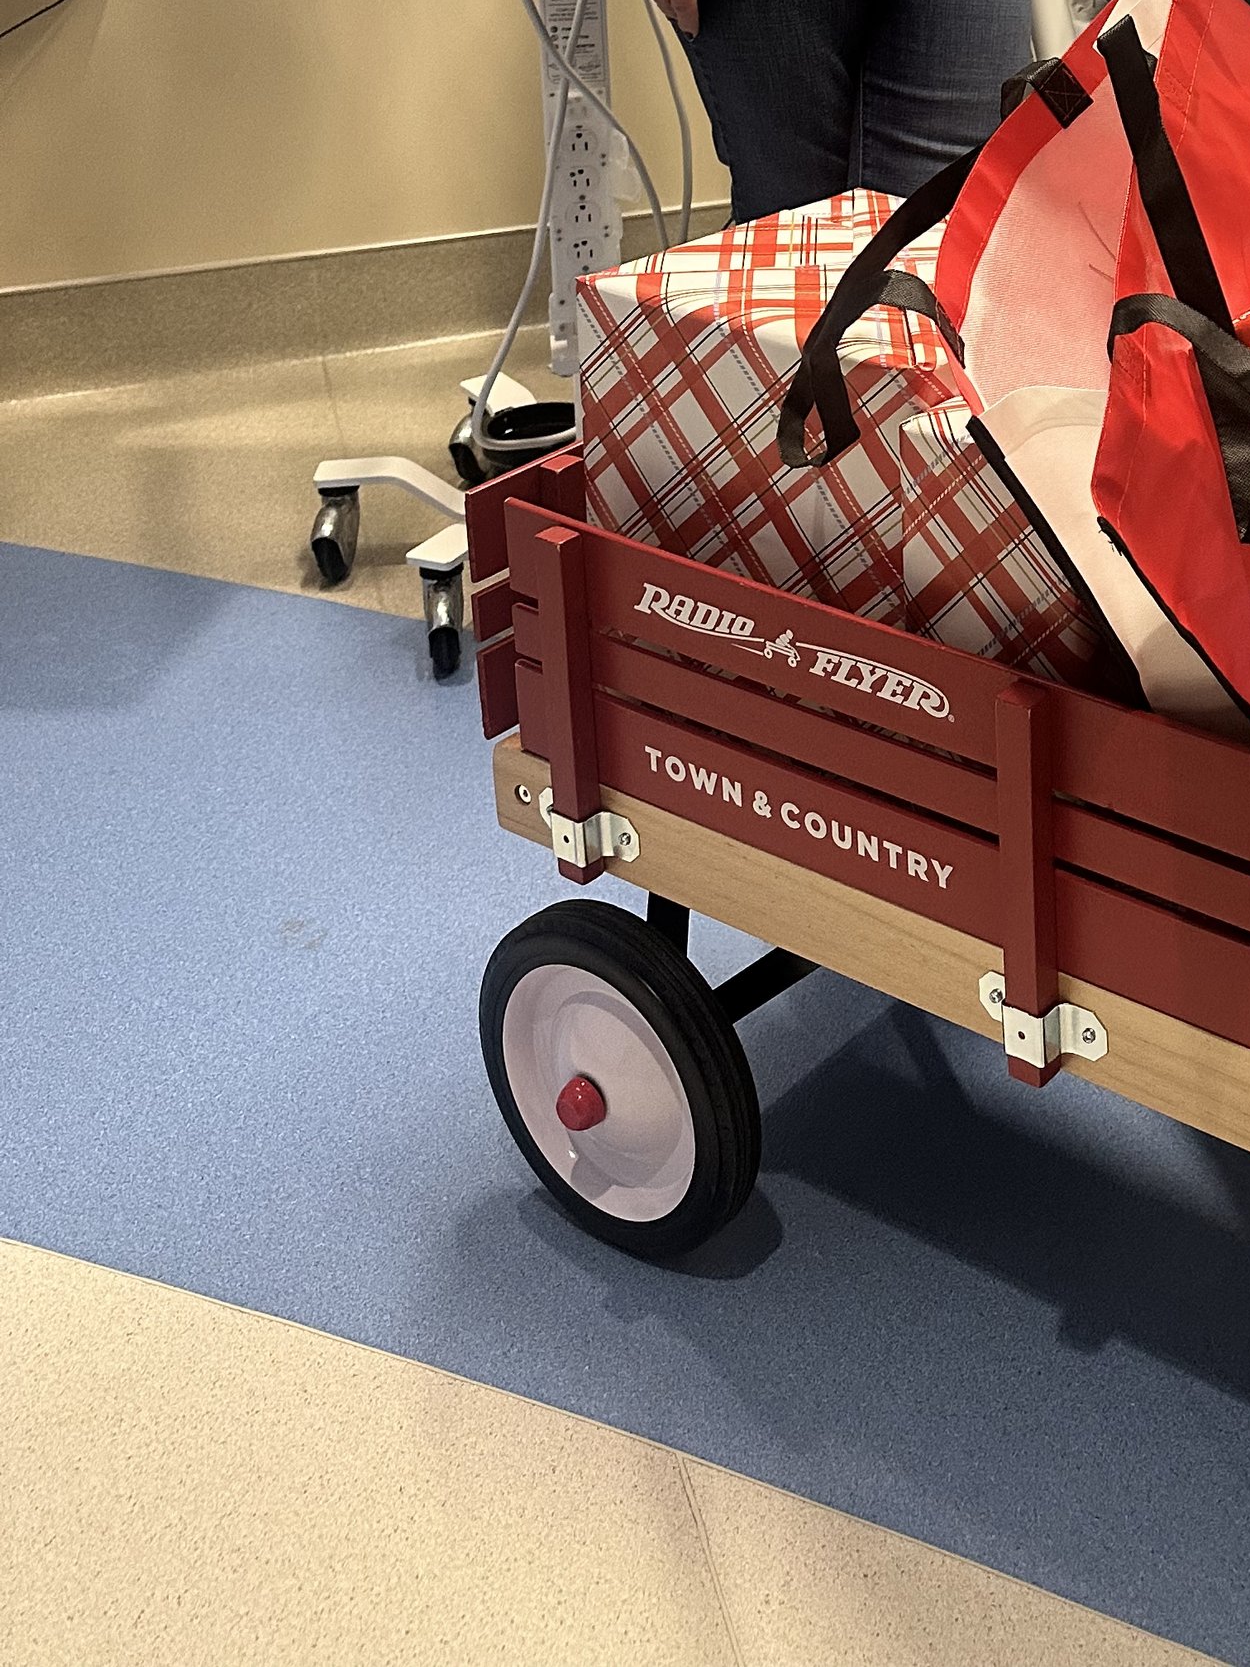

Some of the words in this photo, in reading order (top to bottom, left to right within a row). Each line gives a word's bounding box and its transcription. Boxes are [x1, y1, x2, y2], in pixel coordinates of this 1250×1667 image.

[633, 582, 756, 637] RADIO
[809, 650, 950, 719] FLYER
[644, 745, 743, 807] TOWN
[752, 790, 773, 819] &
[780, 802, 954, 889] COUNTRY
